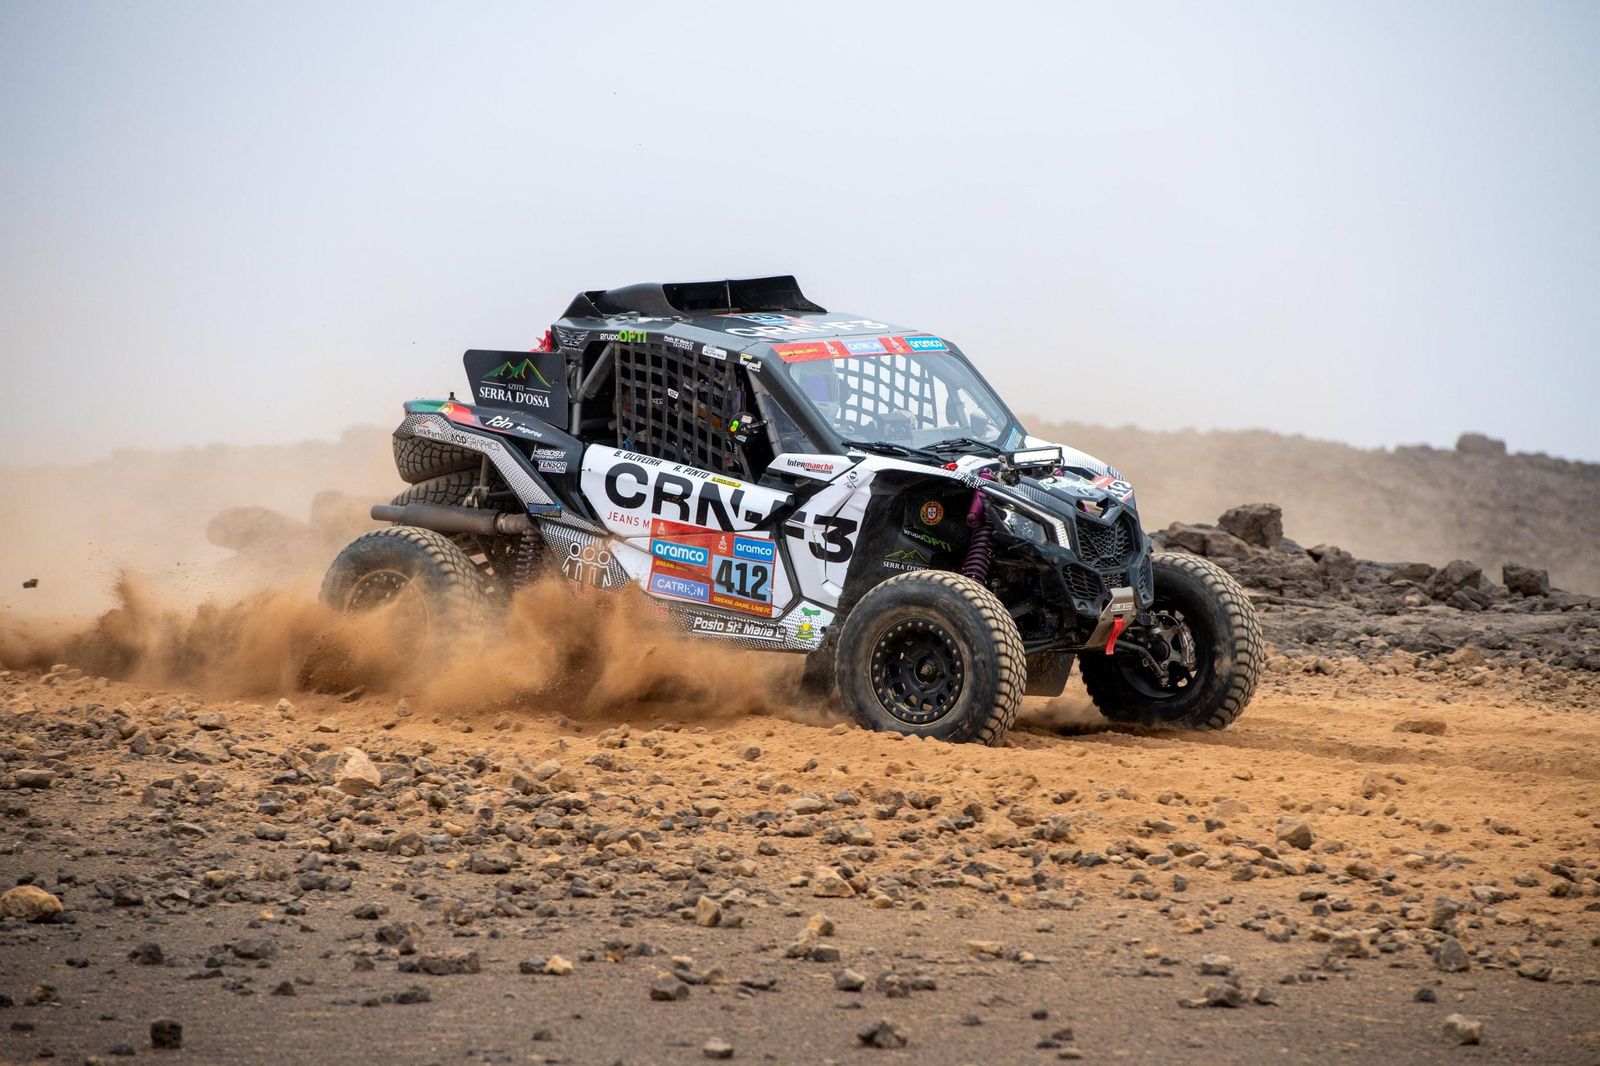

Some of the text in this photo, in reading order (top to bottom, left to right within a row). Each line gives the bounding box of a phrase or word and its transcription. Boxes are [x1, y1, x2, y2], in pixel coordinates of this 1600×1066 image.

[909, 339, 944, 348] aramco
[479, 386, 550, 408] SERRA D'OSSA
[516, 424, 543, 438] seguros
[538, 459, 567, 470] TENSOR
[613, 450, 621, 458] B.
[623, 452, 662, 467] OLIVEIRA
[683, 467, 710, 479] PINTO
[787, 459, 834, 471] Intermarché
[607, 511, 640, 526] JEANS
[655, 543, 705, 562] aramco
[736, 543, 772, 556] aramco
[882, 560, 905, 570] SERRA
[715, 559, 768, 602] 412
[713, 595, 735, 605] DREAM.
[734, 601, 750, 609] DARE.
[693, 617, 725, 631] Posto
[743, 624, 773, 637] Maria
